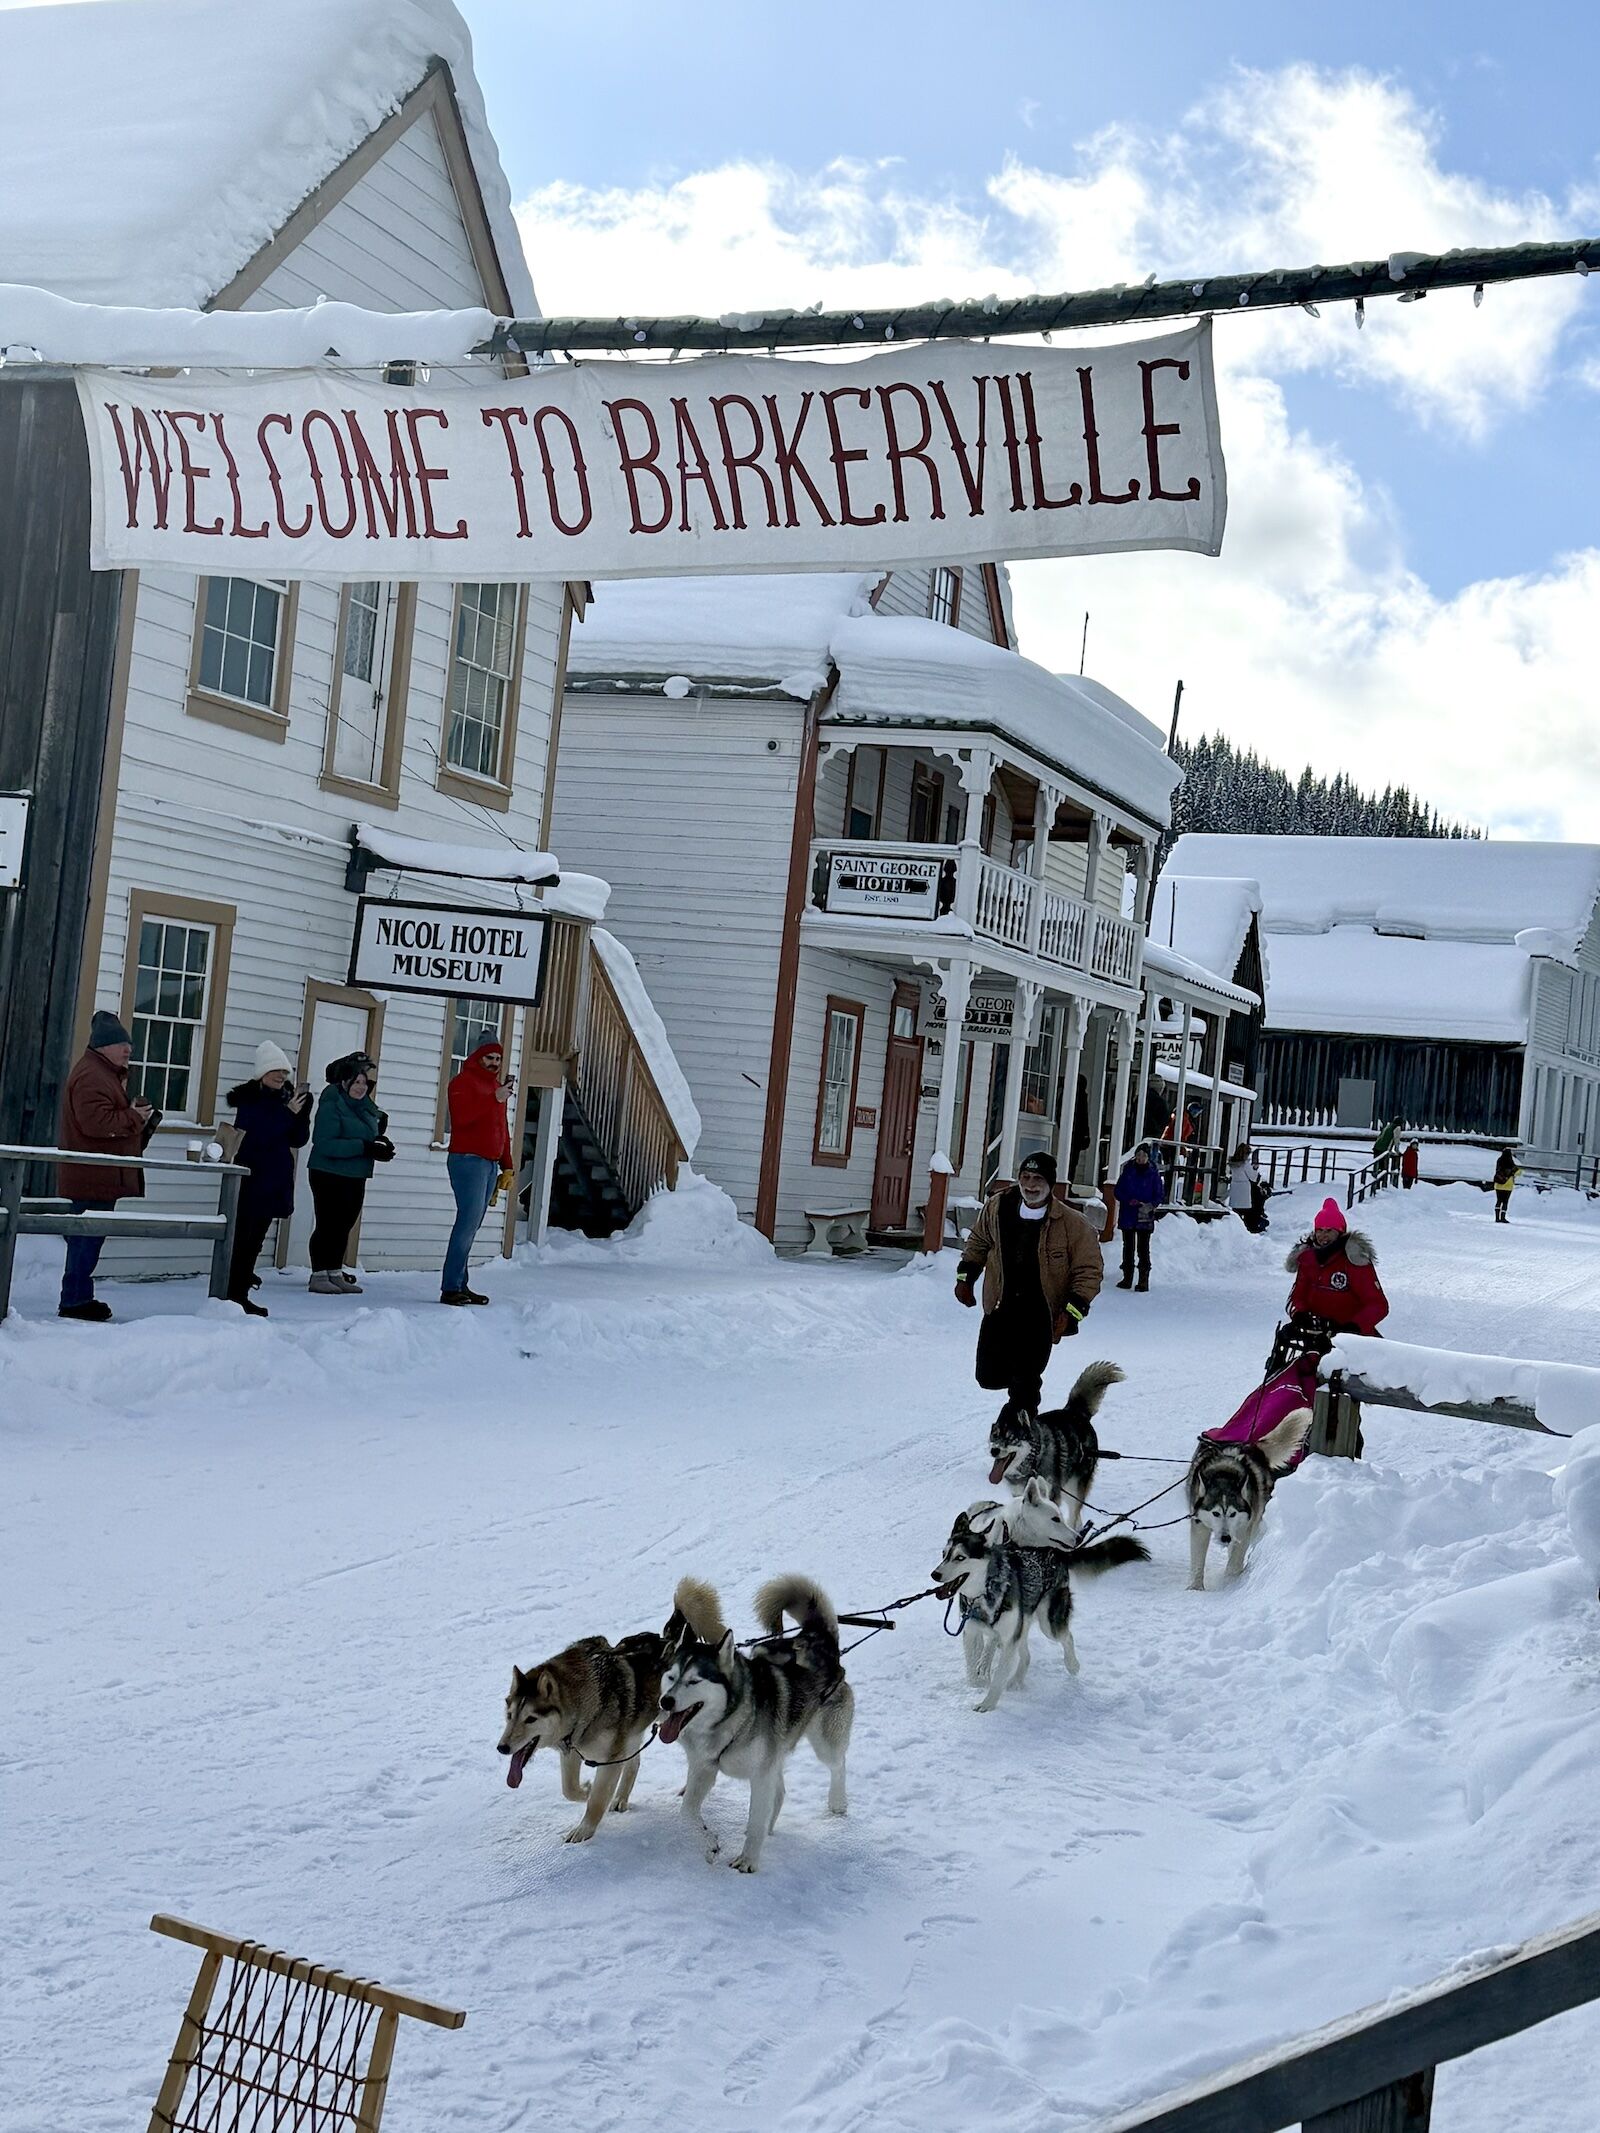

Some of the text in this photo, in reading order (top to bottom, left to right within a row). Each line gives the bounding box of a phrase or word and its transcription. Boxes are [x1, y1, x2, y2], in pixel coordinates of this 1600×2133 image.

[104, 357, 1202, 540] WELCOME TO BARKERVILLE
[833, 858, 937, 878] SAINT GEORGE
[855, 876, 911, 893] HOTEL
[376, 917, 529, 959] NICOL HOTEL
[391, 953, 504, 985] MUSEUM
[975, 996, 1015, 1011] GEOR
[964, 1009, 1011, 1026] OTEL
